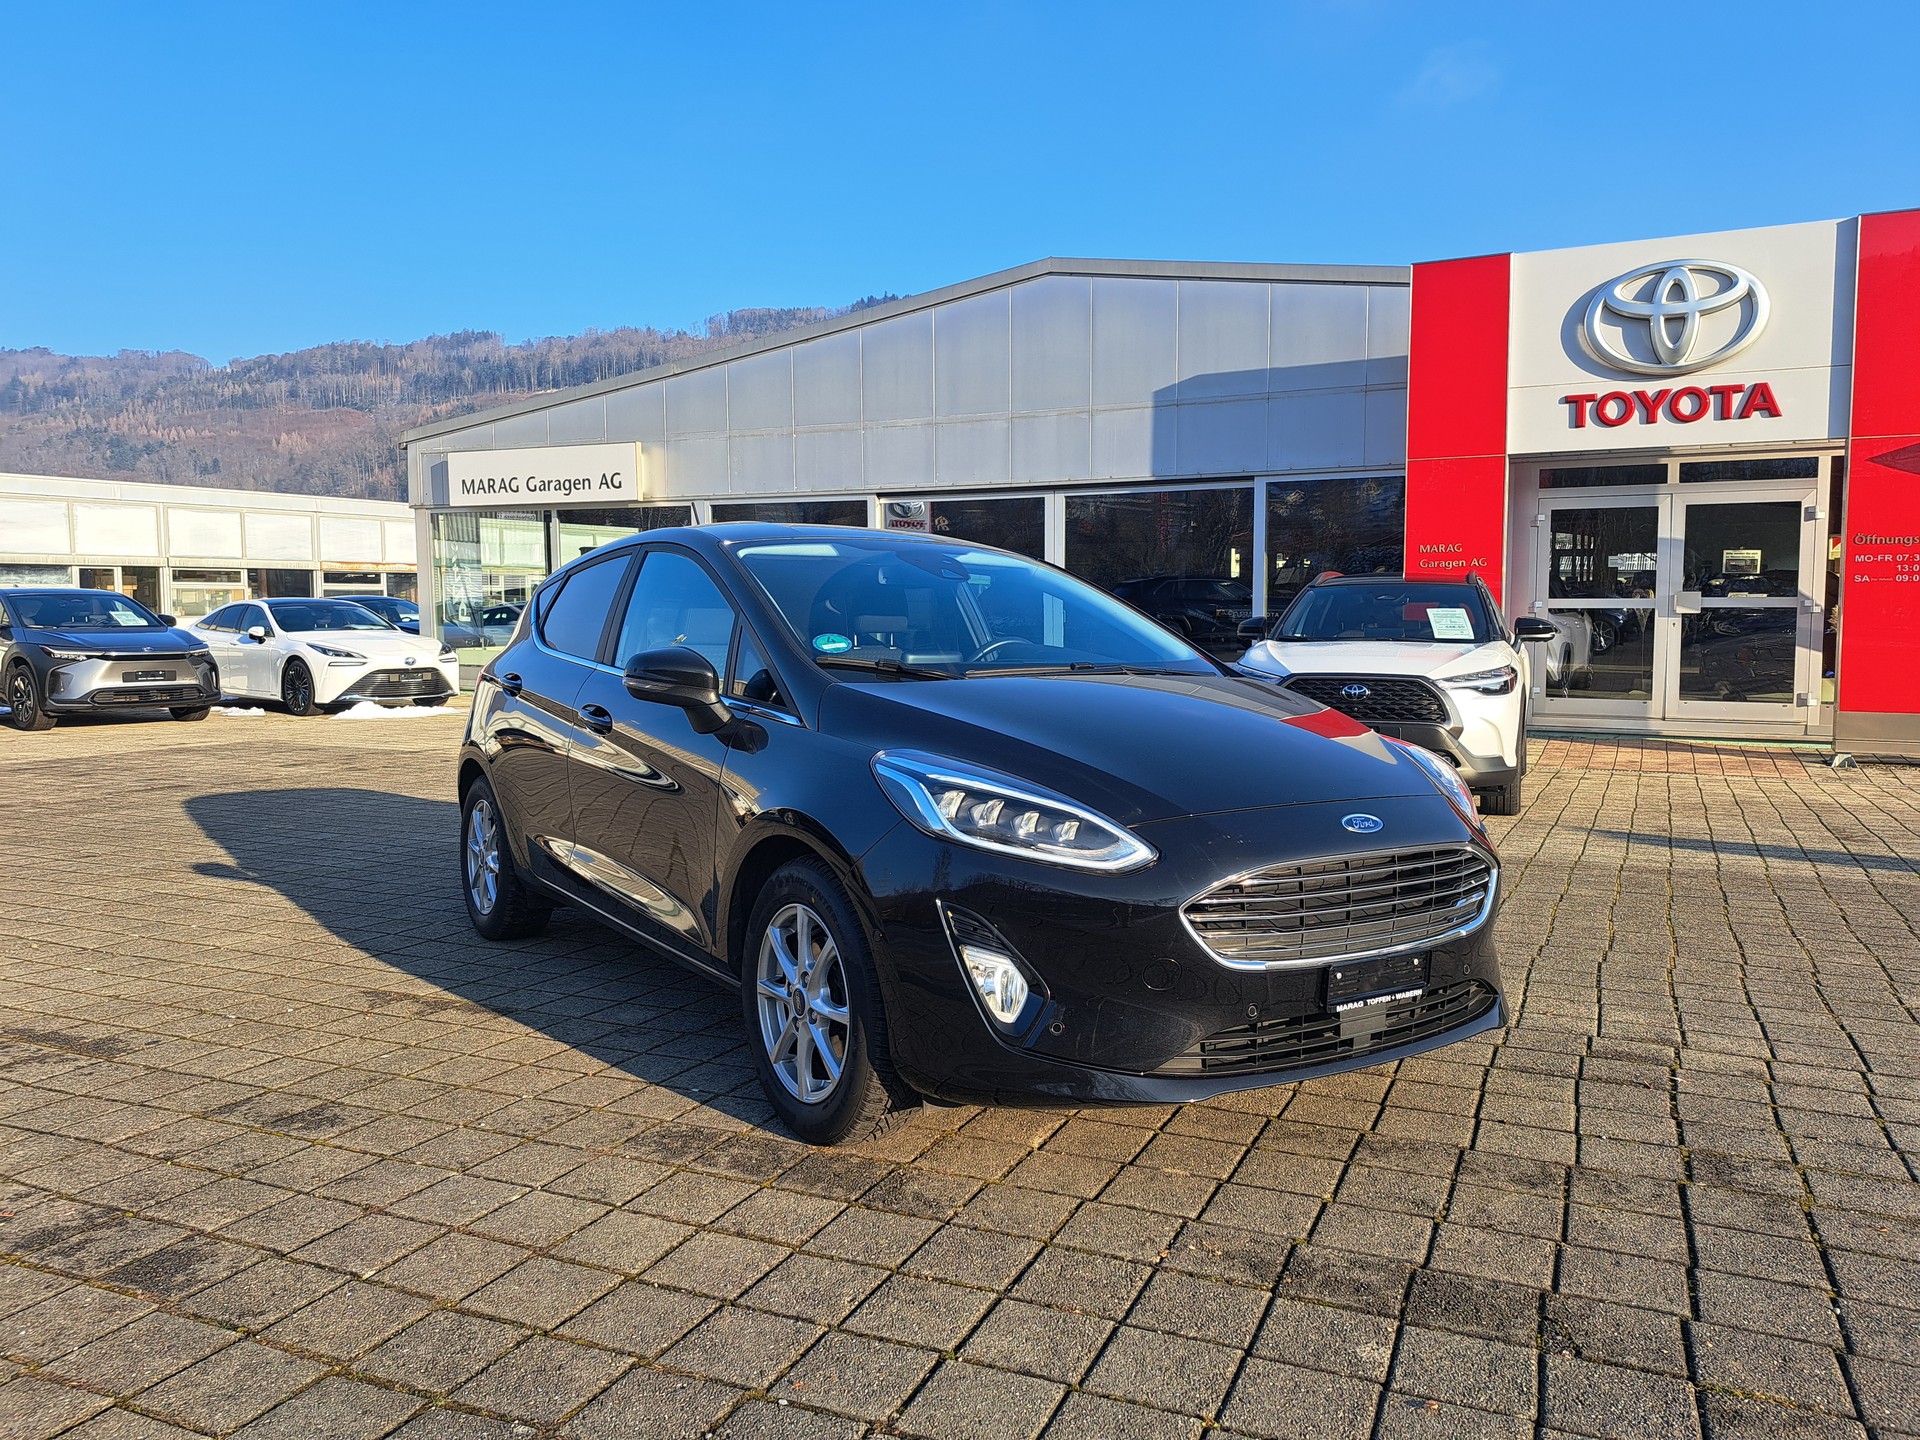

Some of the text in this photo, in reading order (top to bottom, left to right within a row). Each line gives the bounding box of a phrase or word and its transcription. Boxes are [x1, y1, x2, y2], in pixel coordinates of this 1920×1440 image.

[1565, 382, 1783, 428] TOYOTA
[461, 472, 623, 496] MARAG Garagen AG
[1419, 543, 1463, 553] MARAG
[1419, 557, 1487, 570] Garagen AG
[1855, 554, 1893, 562] MO-FR
[1896, 564, 1920, 572] 13:0
[1854, 574, 1870, 582] SA
[1895, 574, 1920, 582] 09:0
[1351, 817, 1375, 829] Ford
[1336, 1001, 1363, 1012] MARAG
[1367, 995, 1391, 1005] TOFFEN
[1396, 989, 1422, 1000] WABERN
